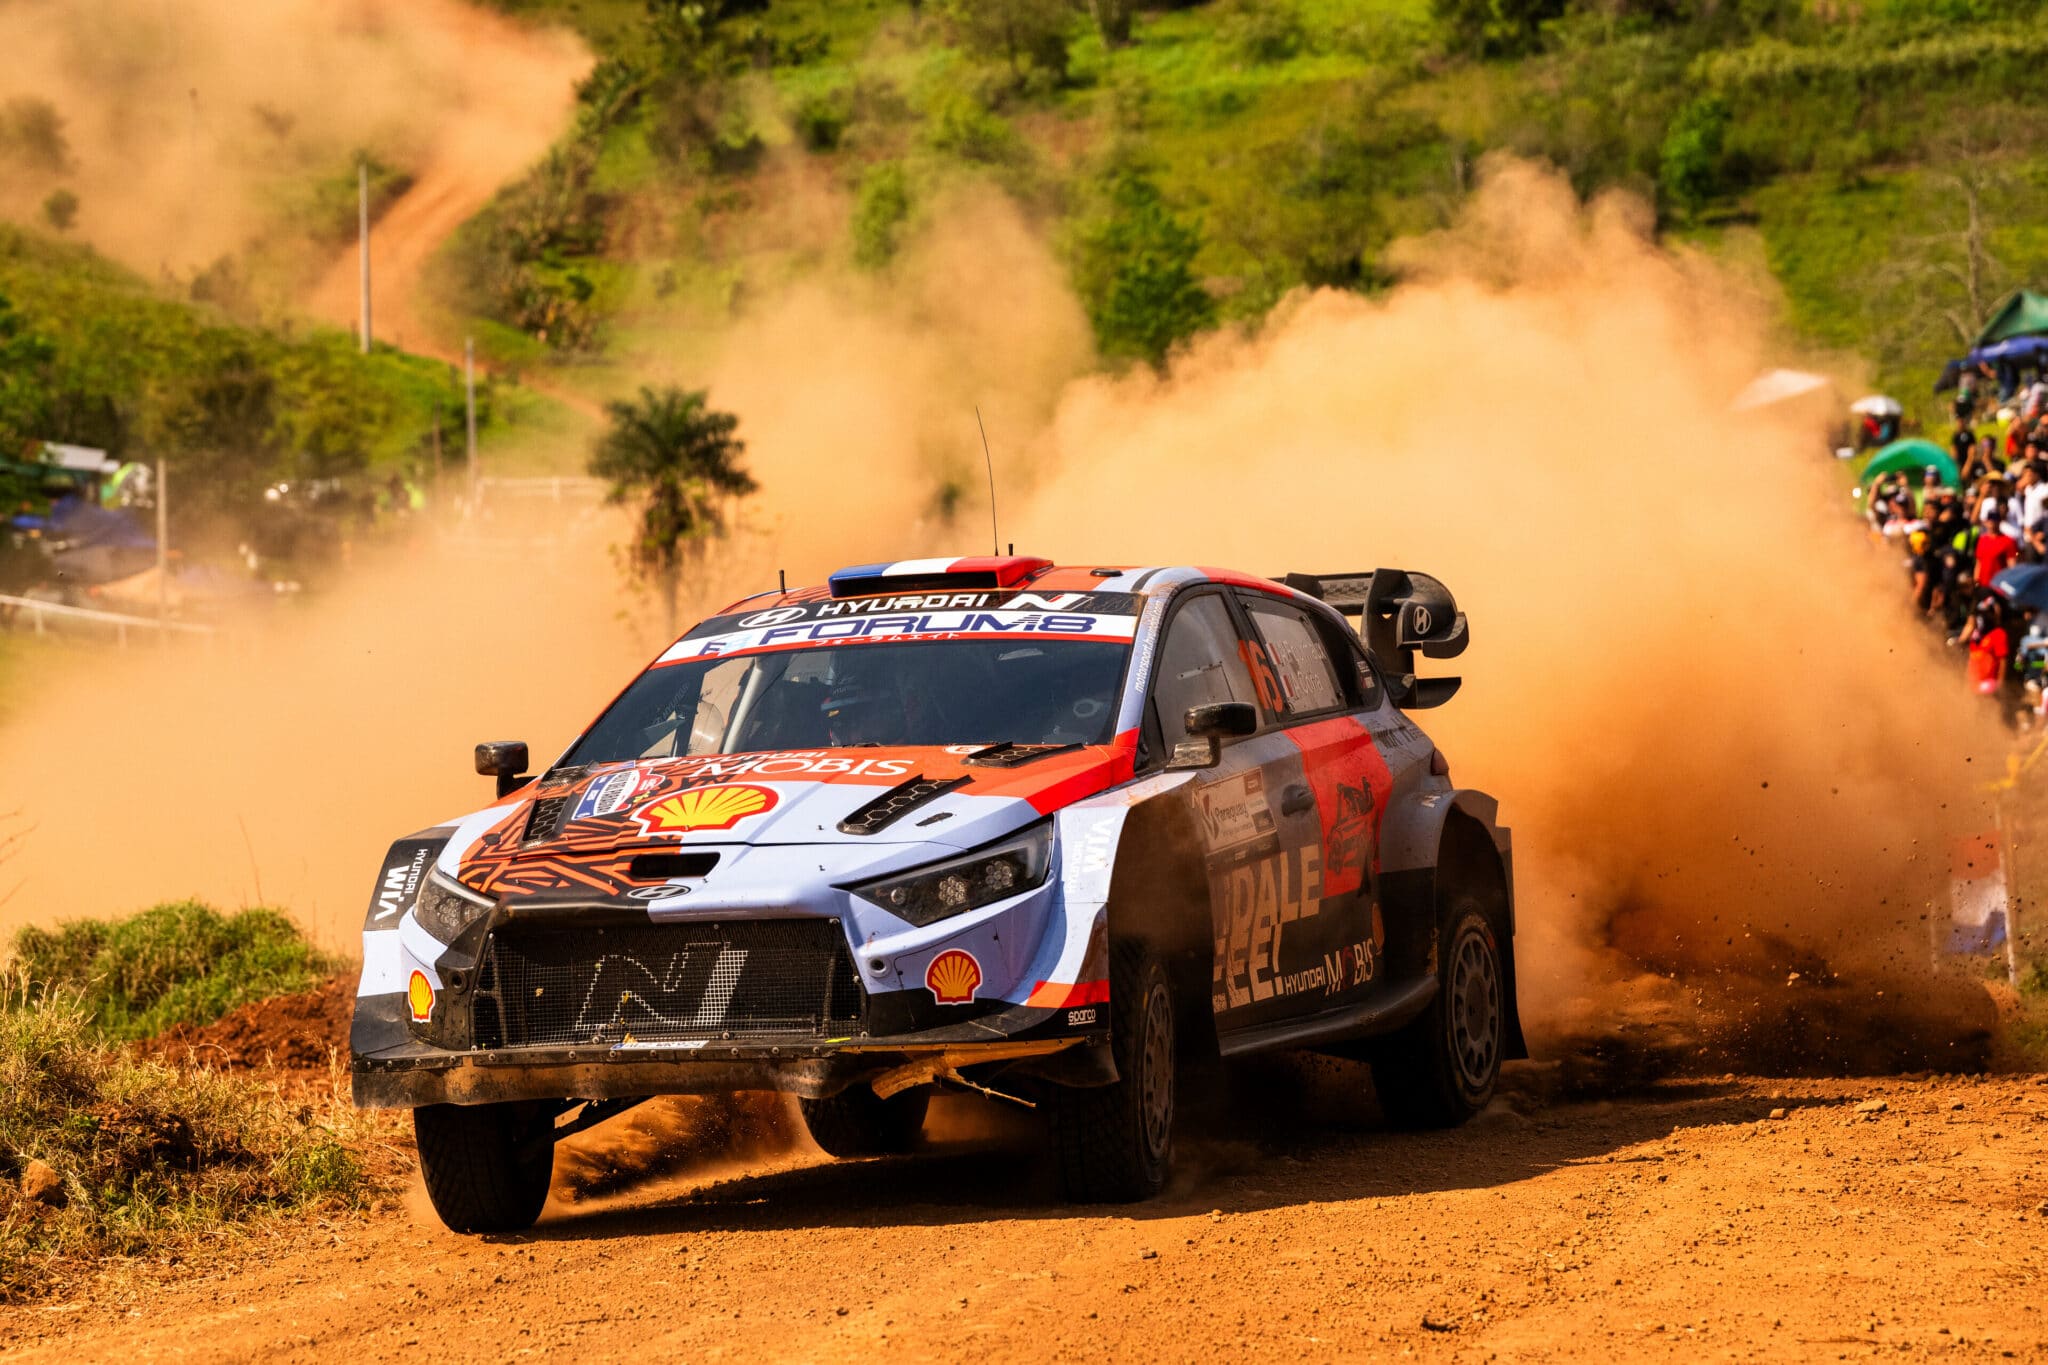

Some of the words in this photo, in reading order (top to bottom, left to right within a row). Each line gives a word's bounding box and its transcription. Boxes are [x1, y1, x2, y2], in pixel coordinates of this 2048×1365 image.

[816, 593, 990, 616] HYUNDAI
[758, 614, 1097, 645] FORUM8
[1238, 639, 1284, 712] 16
[676, 752, 828, 765] HYUNDAI
[687, 758, 915, 777] MOBIS
[403, 848, 429, 894] HYUNDAI
[1283, 965, 1326, 996] HYUNDAI
[1324, 937, 1374, 997] MOBIS
[1067, 1009, 1096, 1025] sparco
